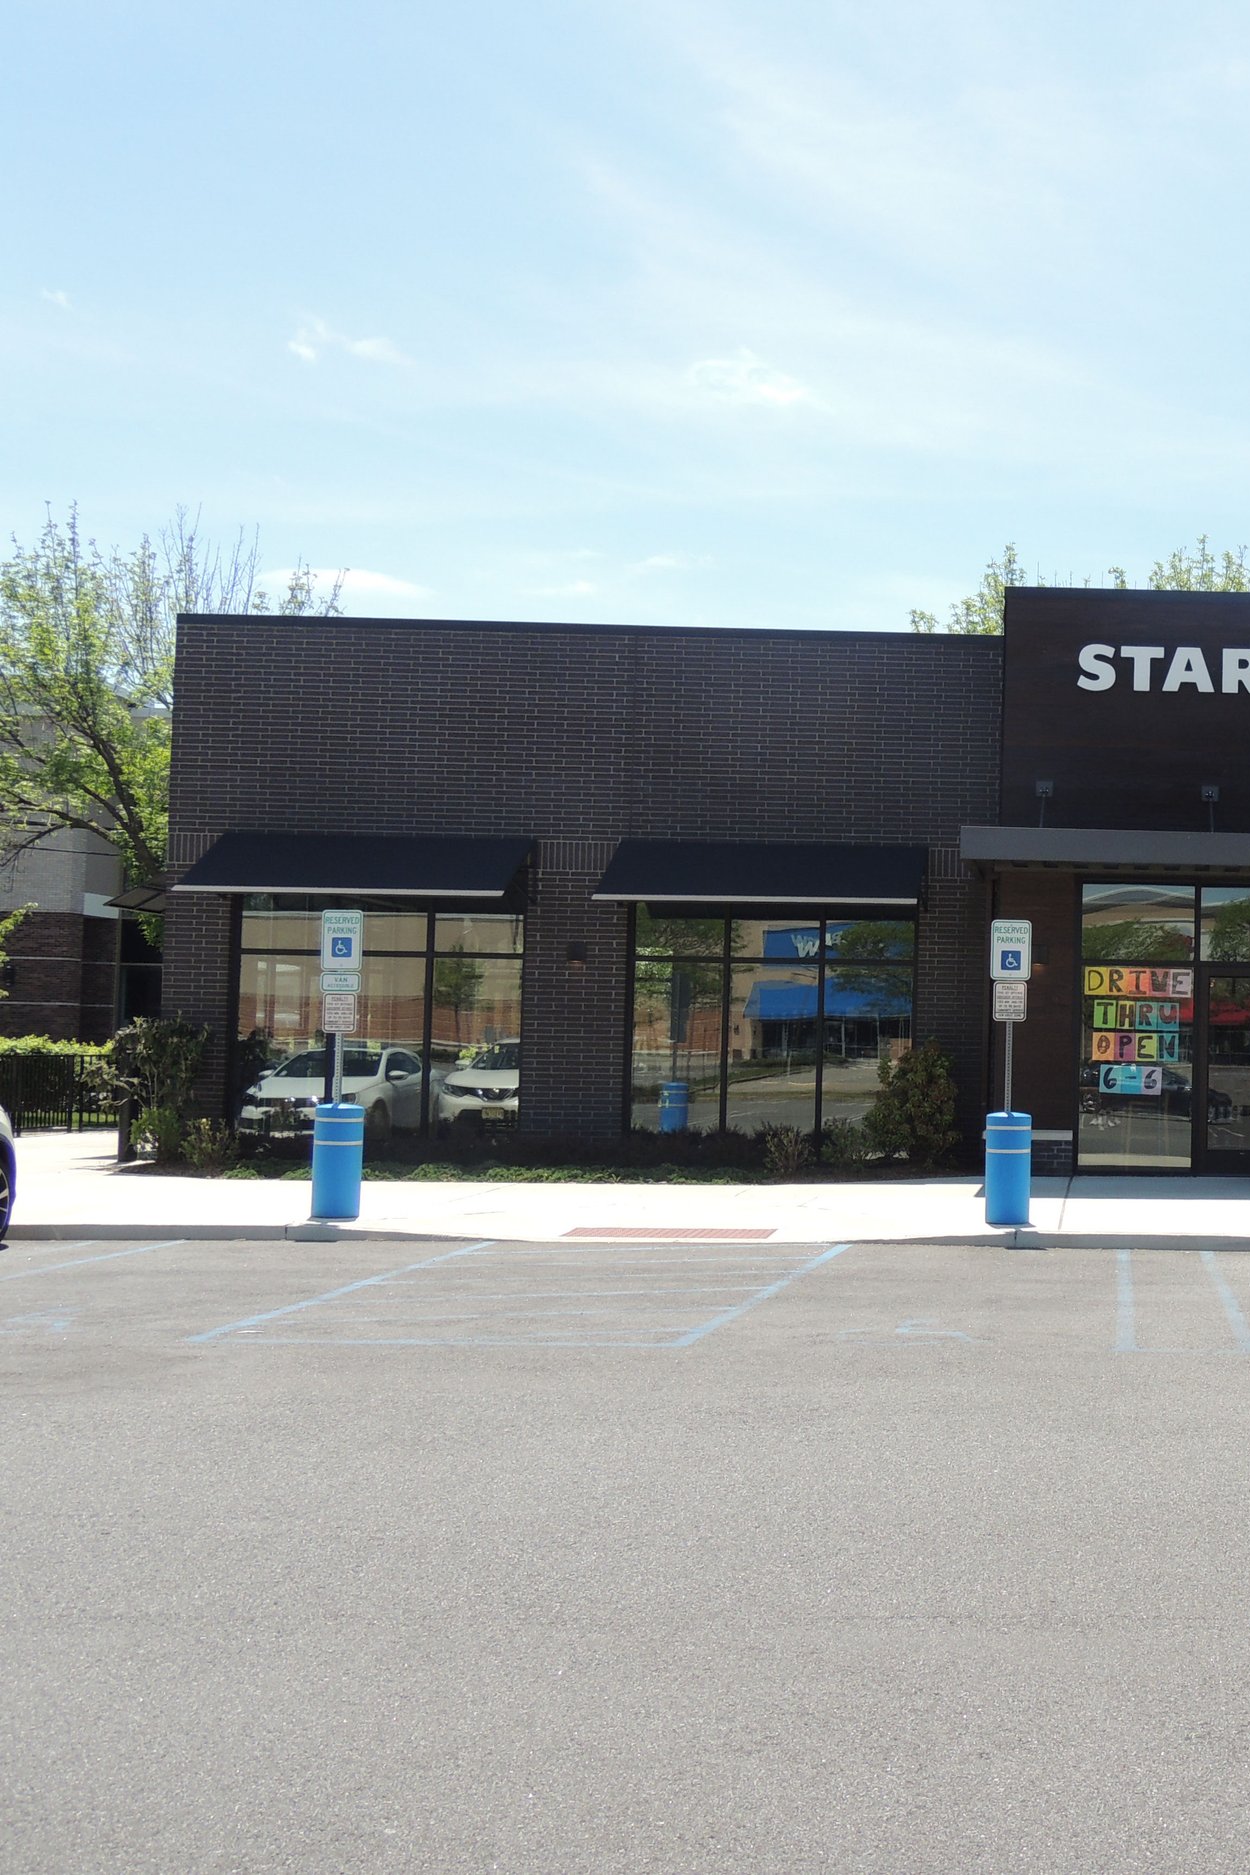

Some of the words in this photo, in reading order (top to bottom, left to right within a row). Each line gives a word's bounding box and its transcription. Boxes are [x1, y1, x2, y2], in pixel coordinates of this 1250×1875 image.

[325, 916, 360, 925] RESERVED
[327, 926, 357, 935] PARKING
[994, 926, 1029, 935] RESERVED
[996, 936, 1026, 945] PARKING
[1087, 968, 1191, 996] DRIVE
[1096, 1001, 1178, 1028] THRU
[1096, 1034, 1176, 1060] OPEN
